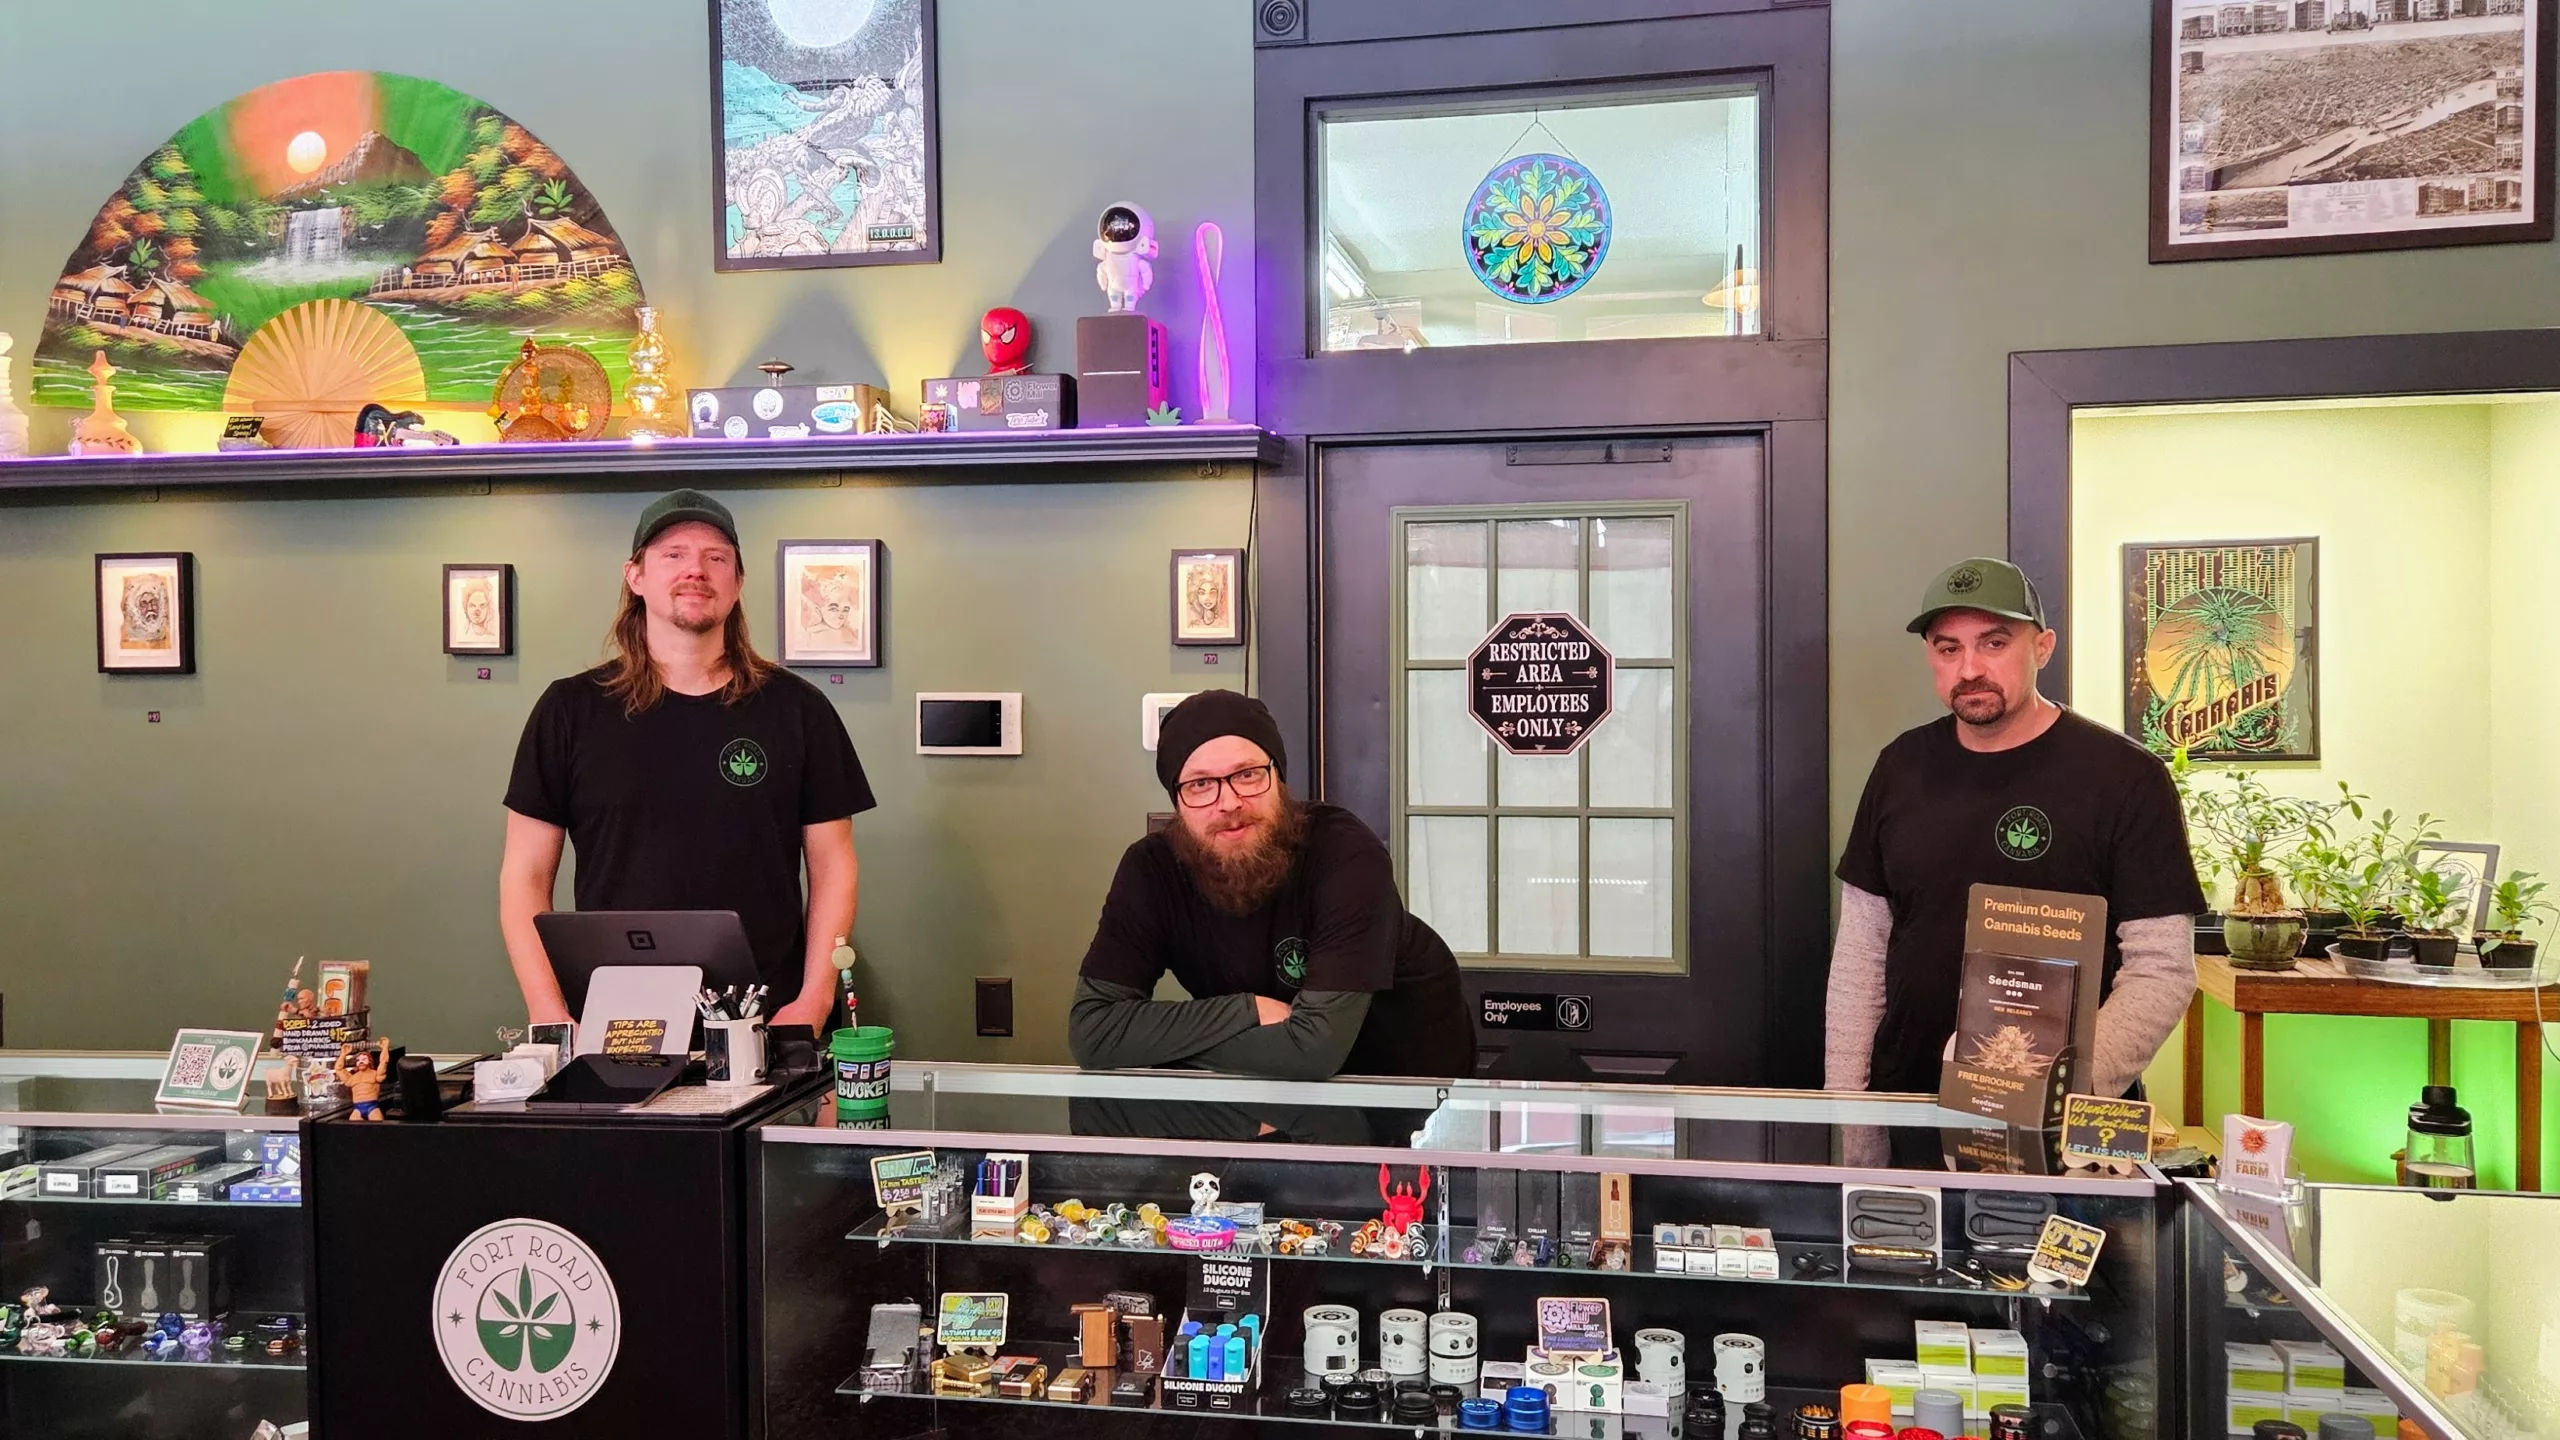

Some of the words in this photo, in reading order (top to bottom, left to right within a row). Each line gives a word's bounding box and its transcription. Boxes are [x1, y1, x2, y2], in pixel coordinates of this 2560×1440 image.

[1489, 642, 1590, 661] RESTRICTED
[1516, 664, 1563, 682] AREA
[1491, 694, 1589, 713] EMPLOYEES
[1517, 718, 1564, 737] ONLY
[1984, 898, 2038, 916] Premium
[2040, 905, 2085, 924] Quality
[1984, 918, 2040, 936] Cannabis
[2042, 924, 2082, 941] Seeds
[1988, 975, 2043, 991] Seedsman
[1484, 1000, 1541, 1012] Employees
[613, 1021, 635, 1029] TIPS
[636, 1020, 657, 1028] ARE
[1484, 1011, 1508, 1024] Only
[605, 1029, 664, 1038] APPRECIATED
[611, 1038, 627, 1046] BUT
[606, 1045, 653, 1054] EXPECTED
[838, 1060, 891, 1079] TIP
[838, 1078, 890, 1098] BUCKET
[1958, 1071, 1978, 1082] FREE
[1979, 1075, 2025, 1091] BROCHURE
[2071, 1100, 2109, 1114] Want
[2108, 1104, 2146, 1118] What
[2069, 1114, 2088, 1127] We
[2119, 1119, 2149, 1133] have
[2099, 1128, 2116, 1148] ?
[2067, 1143, 2089, 1154] LET
[2091, 1147, 2110, 1156] US
[2236, 1164, 2269, 1177] FARM
[457, 1235, 514, 1289] FORT
[528, 1236, 593, 1291] ROAD
[1202, 1264, 1253, 1277] SILICONE
[1203, 1275, 1251, 1288] DUGOUT
[1571, 1302, 1601, 1313] Flower
[1571, 1312, 1588, 1322] Mill
[466, 1358, 588, 1404] CANNABIS
[1164, 1381, 1204, 1391] SILICONE
[1205, 1383, 1244, 1393] DUGOUT
